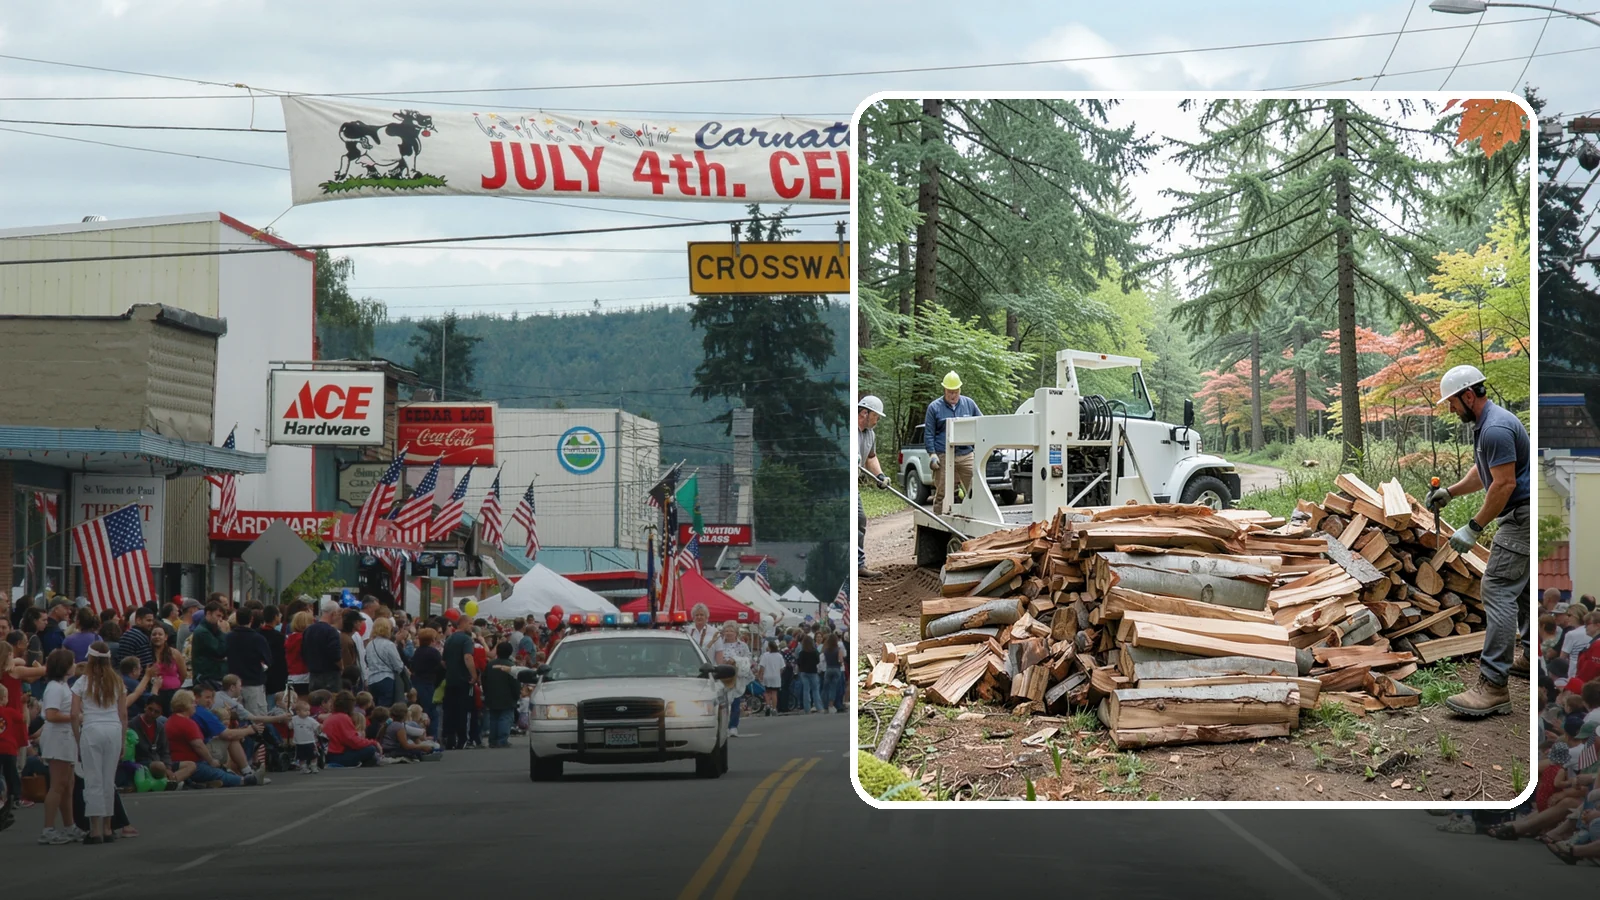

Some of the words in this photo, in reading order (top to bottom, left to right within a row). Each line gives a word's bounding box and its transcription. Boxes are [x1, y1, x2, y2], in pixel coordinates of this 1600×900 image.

[695, 121, 850, 150] Carnat
[481, 141, 604, 192] JULY
[633, 150, 746, 198] 4th.
[697, 254, 850, 281] CROSSWA
[283, 380, 373, 420] ACE
[405, 408, 452, 422] CEDAR
[461, 409, 485, 422] LOG
[284, 420, 370, 437] Hardware
[416, 427, 477, 447] Coca-Cola
[353, 467, 385, 481] Simpl
[83, 484, 93, 494] St.
[95, 485, 124, 495] Vincent
[126, 486, 136, 495] de
[138, 486, 155, 495] Paul
[688, 526, 741, 536] CRNATION
[699, 535, 730, 543] GLASS
